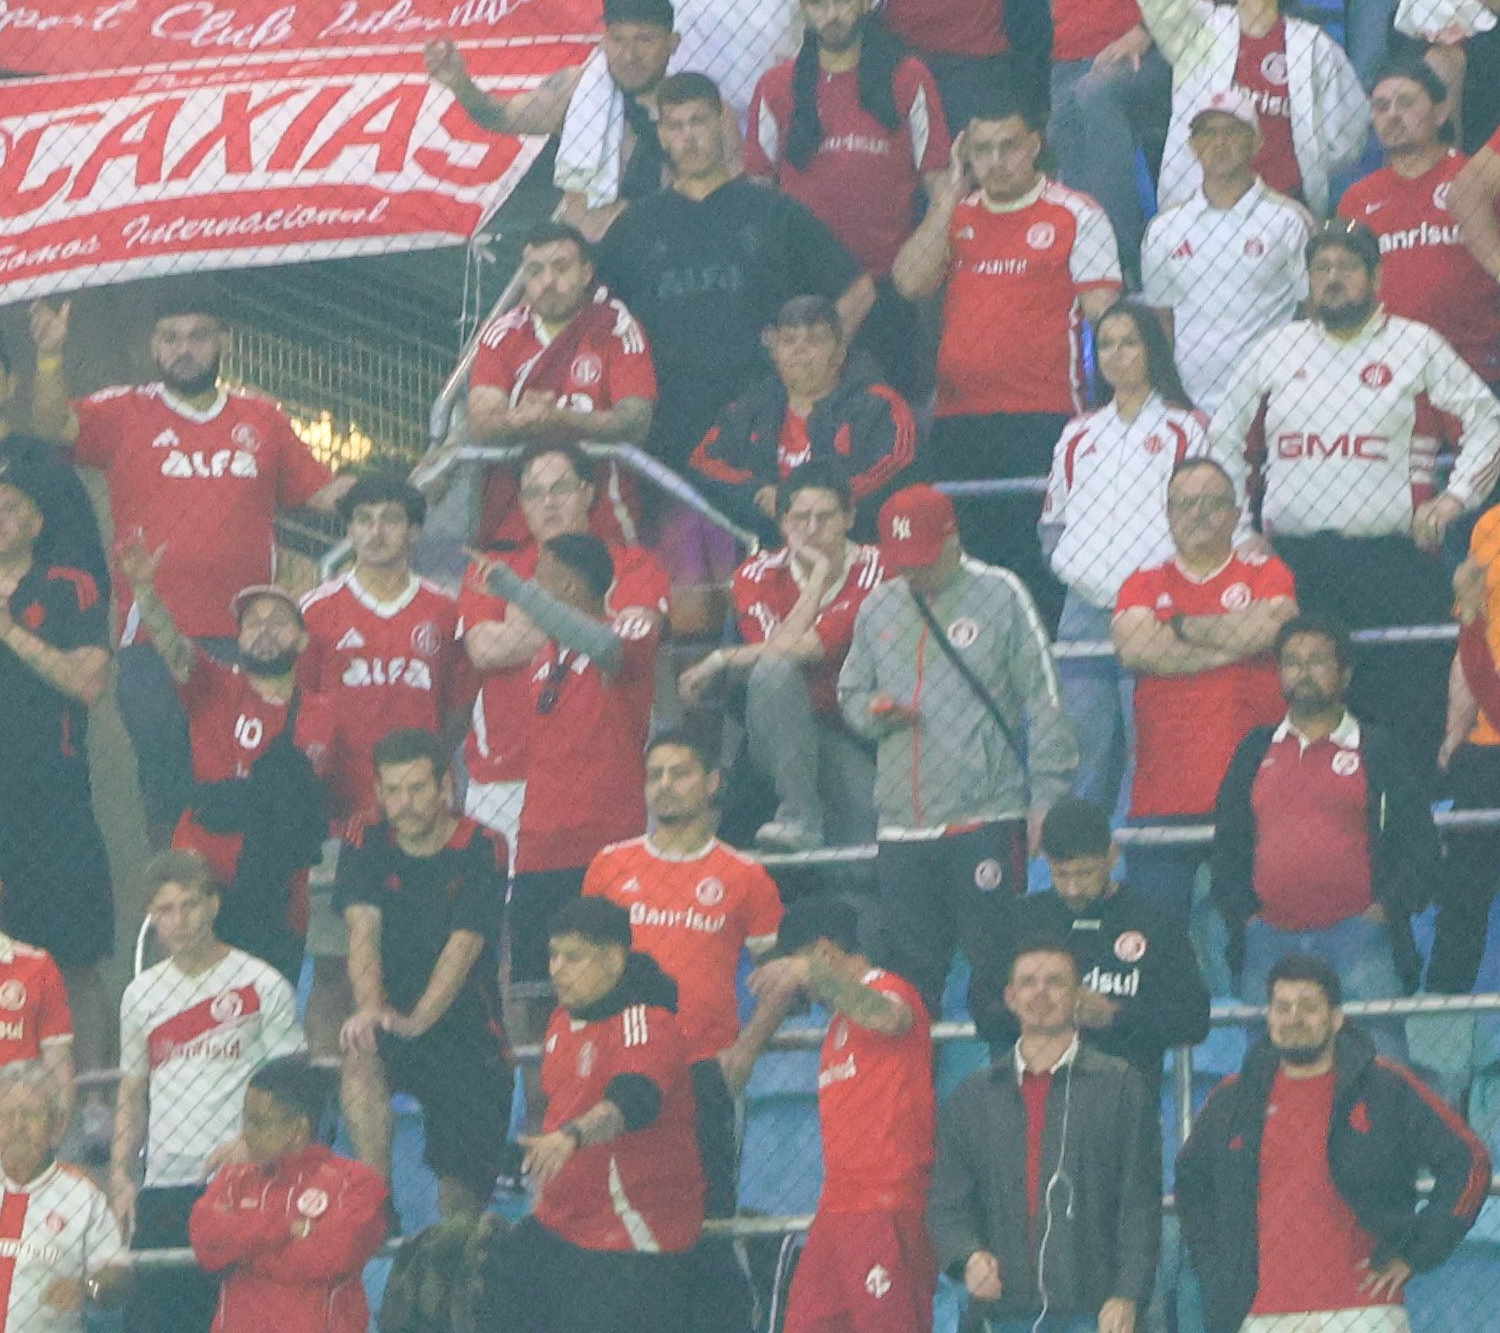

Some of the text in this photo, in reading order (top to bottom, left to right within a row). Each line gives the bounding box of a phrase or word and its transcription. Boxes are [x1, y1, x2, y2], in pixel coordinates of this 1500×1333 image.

[150, 0, 297, 50] Club
[122, 196, 389, 251] Internacional
[1276, 433, 1388, 463] GMC
[234, 713, 263, 749] 10
